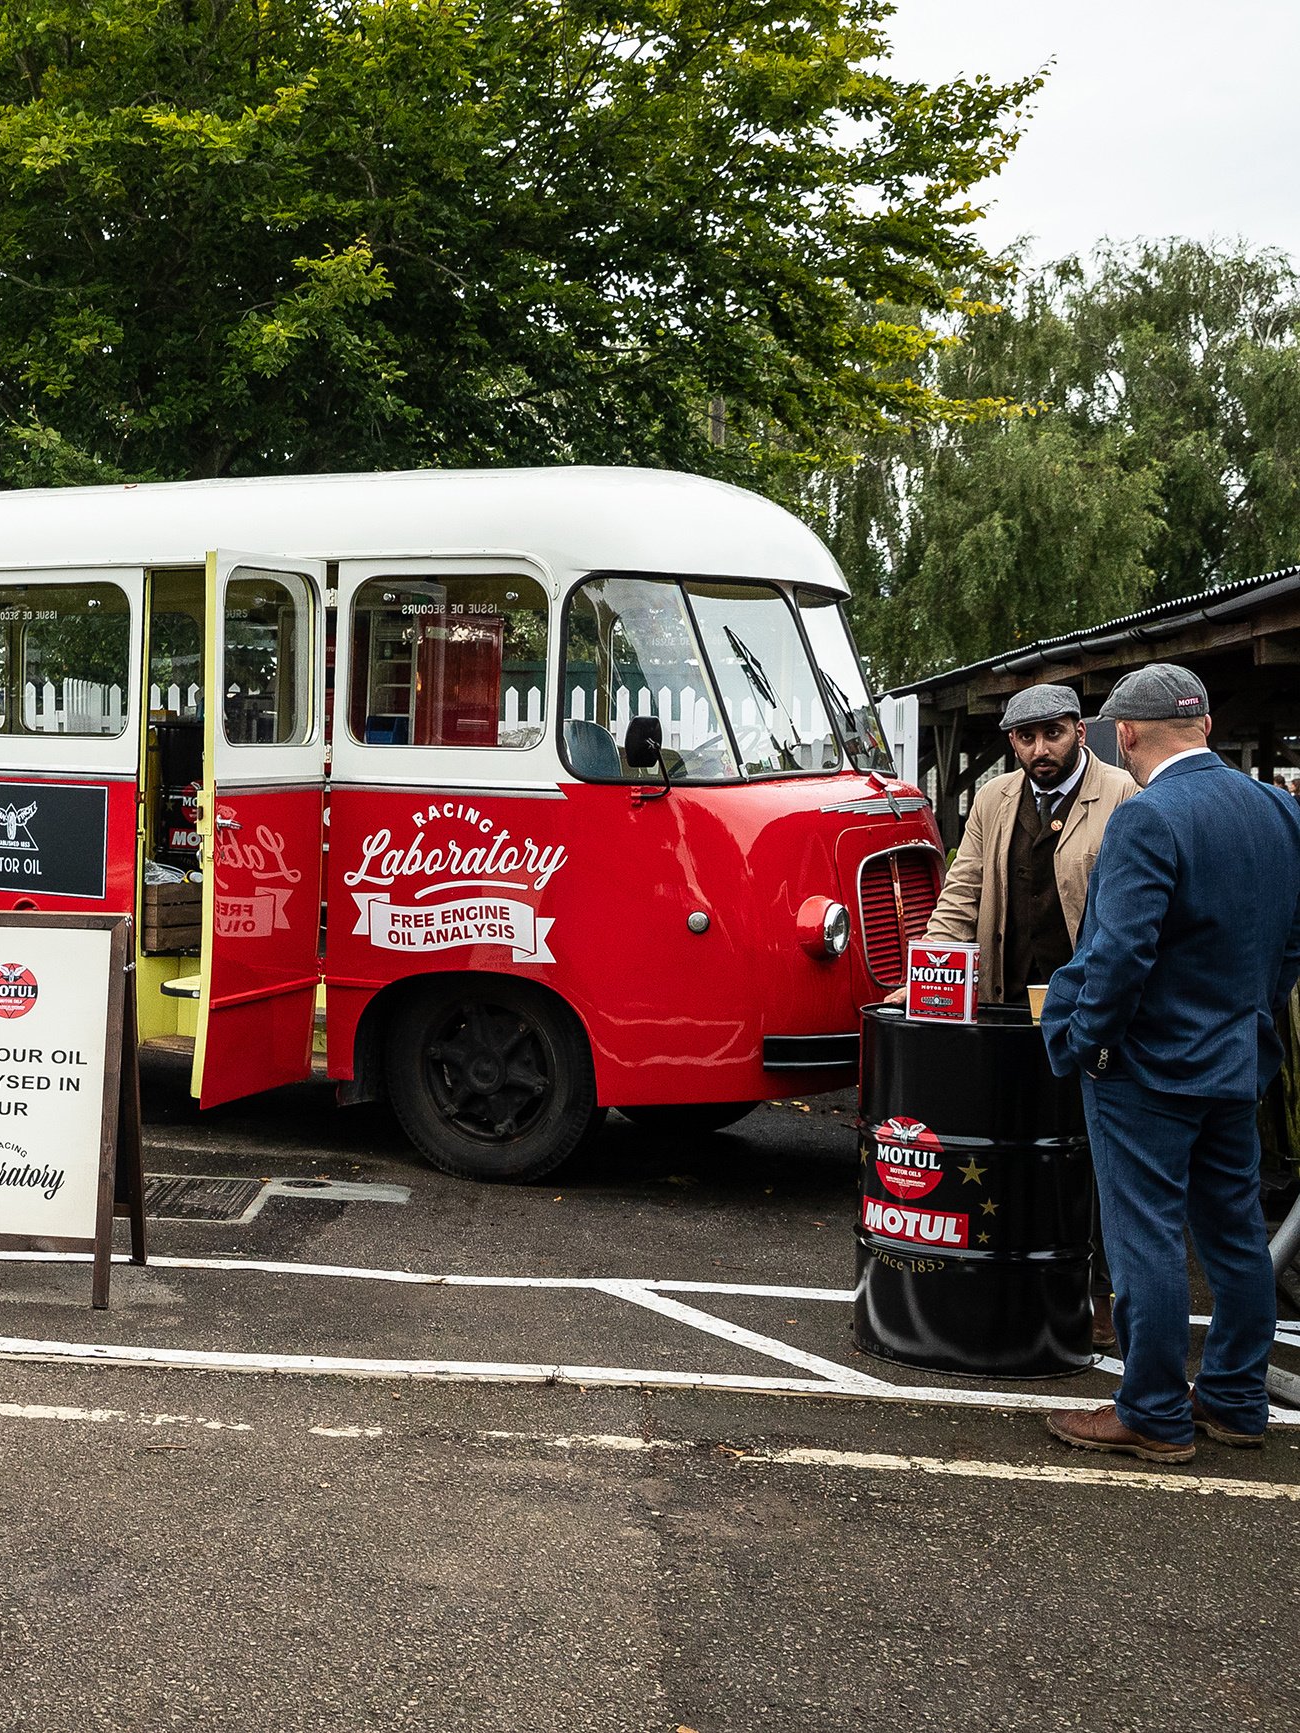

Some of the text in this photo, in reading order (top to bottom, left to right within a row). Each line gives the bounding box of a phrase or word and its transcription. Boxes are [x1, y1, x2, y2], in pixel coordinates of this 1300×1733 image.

[412, 803, 494, 834] RACING
[23, 858, 42, 875] OIL
[343, 828, 569, 892] Laboratory
[390, 905, 511, 929] FREE ENGINE
[387, 923, 516, 946] OIL ANALYSIS
[911, 966, 965, 985] MOTUL
[51, 1050, 88, 1065] OIL
[59, 1077, 80, 1091] IN
[877, 1143, 941, 1170] MOTUL
[889, 1166, 922, 1178] MOTOR OILS
[865, 1201, 962, 1243] MOTUL
